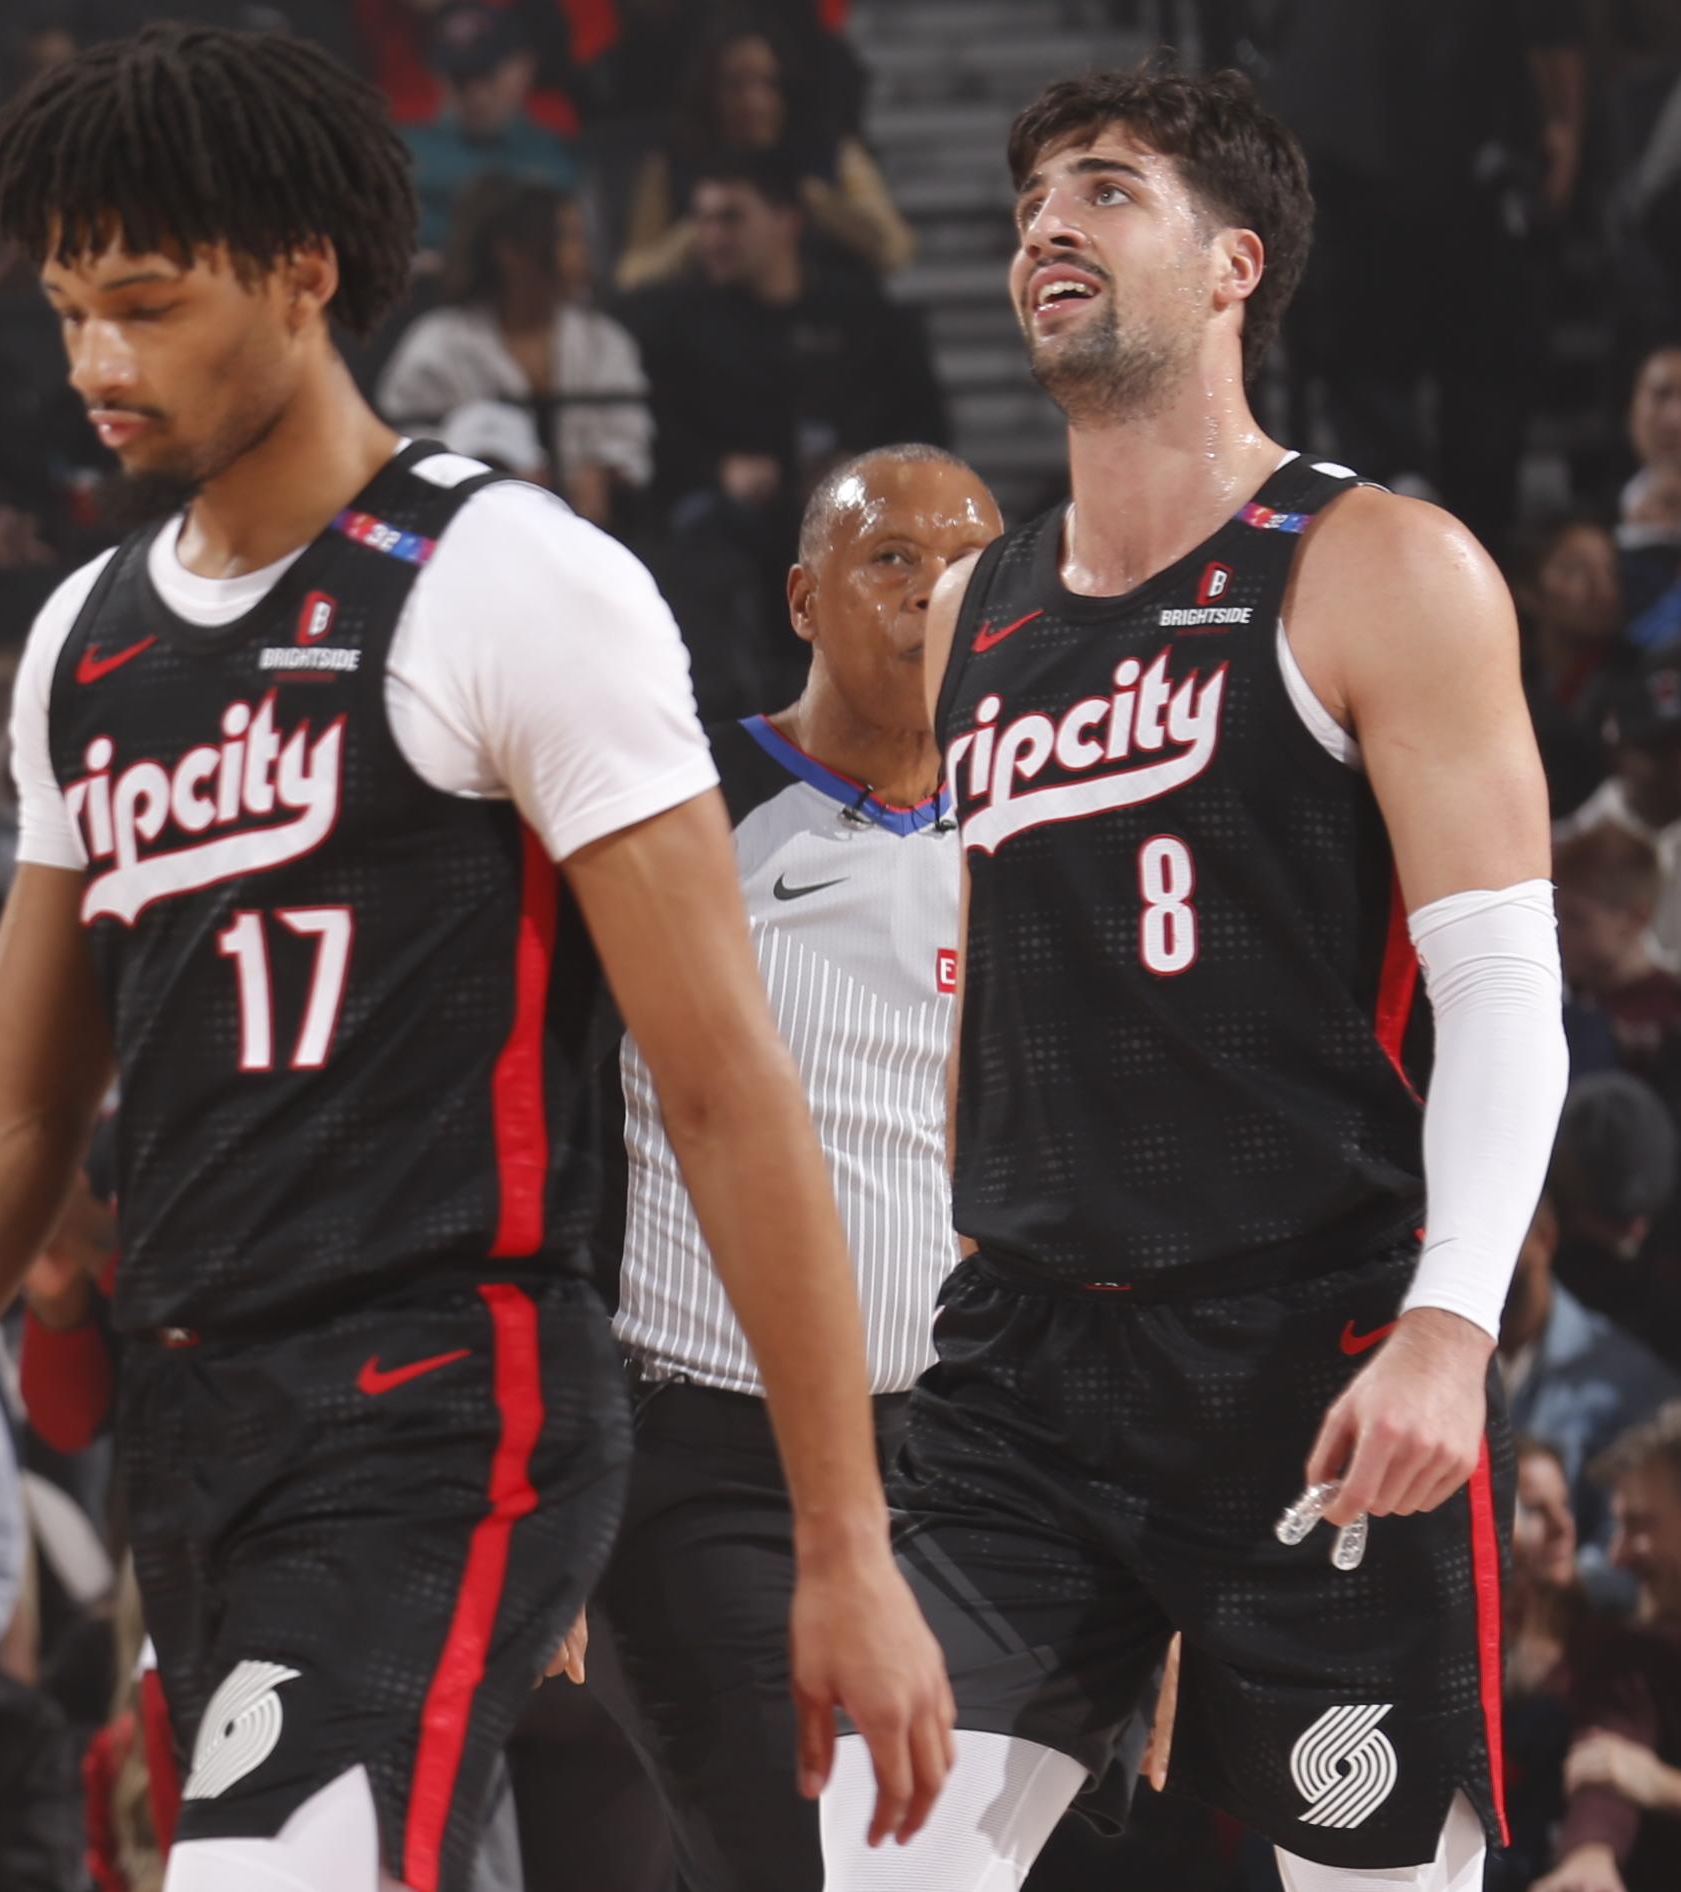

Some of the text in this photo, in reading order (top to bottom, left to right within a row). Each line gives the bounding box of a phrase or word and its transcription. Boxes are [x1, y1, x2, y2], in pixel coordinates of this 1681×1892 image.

[365, 523, 401, 551] 32
[1159, 607, 1254, 627] BRIGHTSIDE
[1208, 570, 1227, 597] B
[258, 647, 362, 672] BRIGHTSIDE
[945, 644, 1230, 857] ripcity
[62, 685, 347, 926] ripcity
[1136, 833, 1200, 976] 8
[216, 904, 355, 1072] 17
